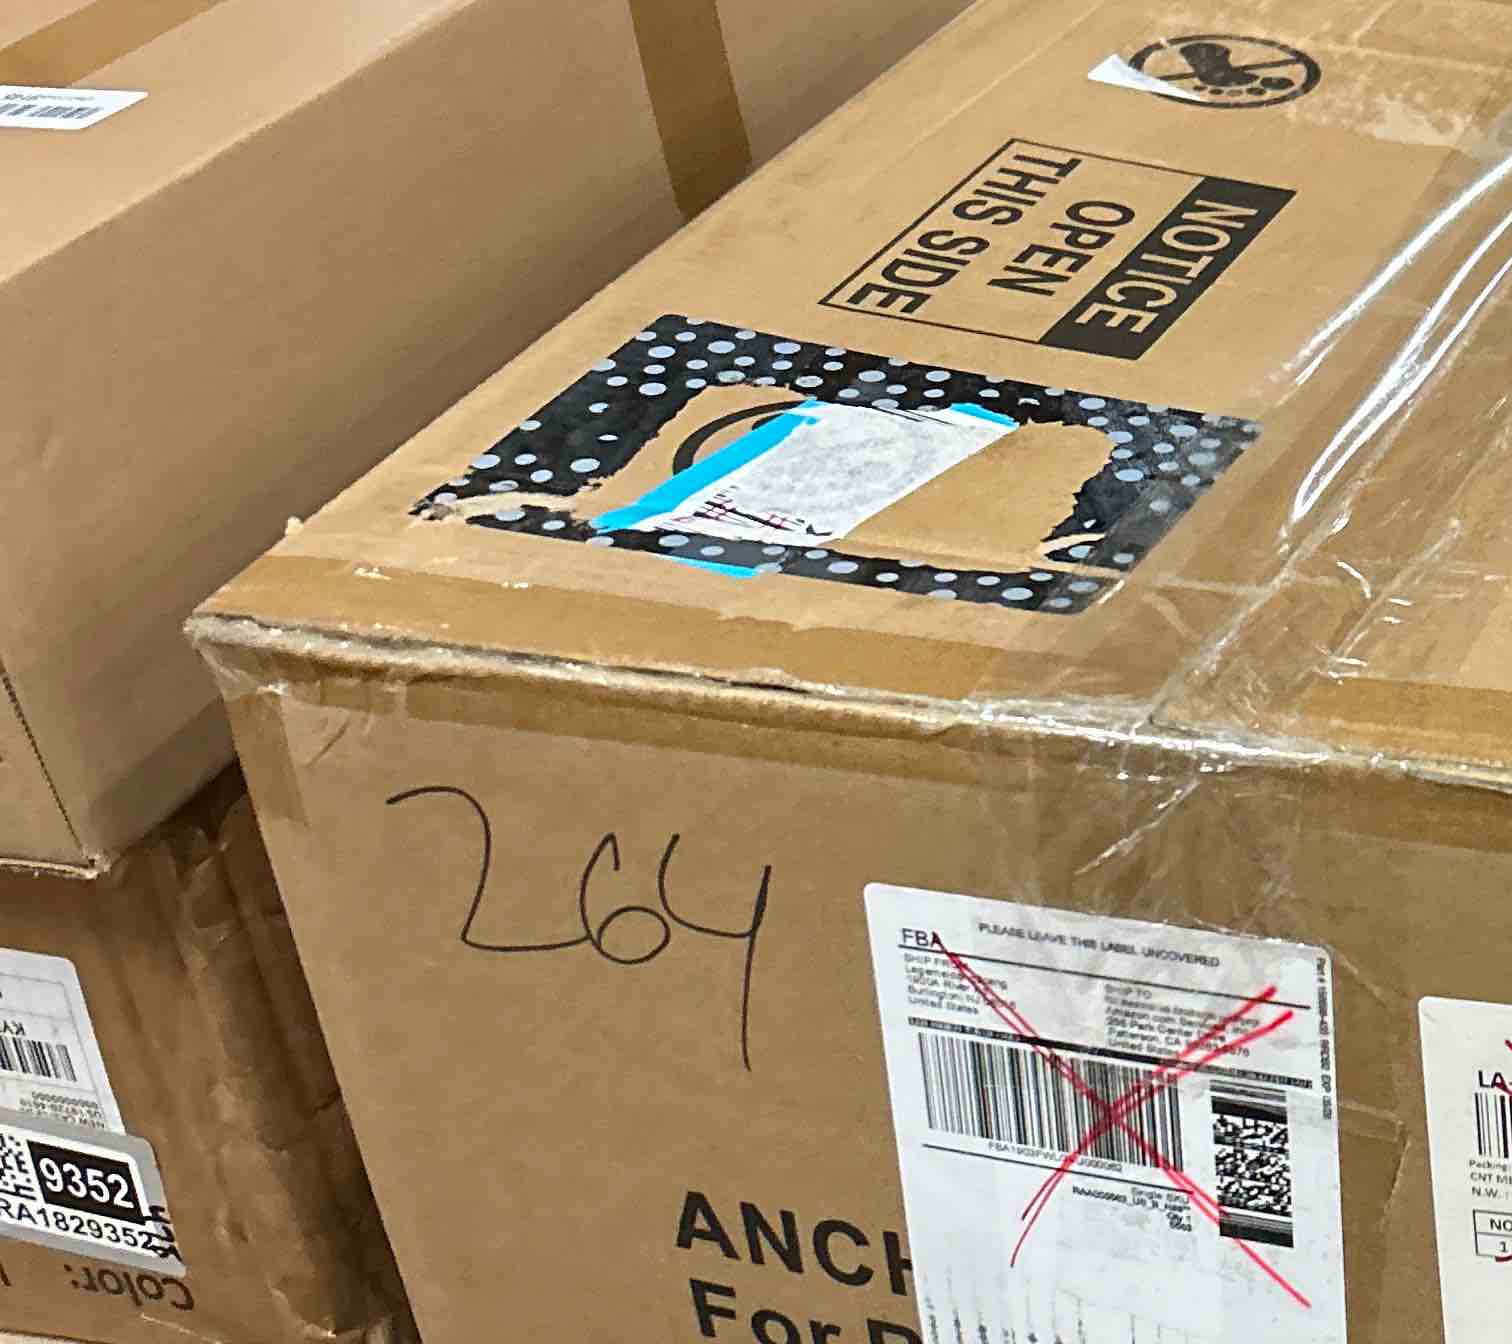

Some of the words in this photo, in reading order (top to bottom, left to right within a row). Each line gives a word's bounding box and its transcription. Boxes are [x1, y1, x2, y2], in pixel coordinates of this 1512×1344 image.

[951, 153, 1083, 227] THIS
[846, 229, 990, 315] SIDE
[986, 199, 1136, 297] OPEN
[1074, 198, 1263, 335] NOTICE
[386, 784, 773, 1074] 264
[901, 926, 942, 948] FBA
[978, 922, 1026, 939] PLEASE
[1028, 930, 1067, 946] LEAVE
[1070, 936, 1097, 951] THIS
[1100, 941, 1138, 956] LABEL
[1141, 946, 1220, 968] UNCOVERED
[37, 1156, 136, 1210] 9352
[64, 1263, 195, 1312] Color:
